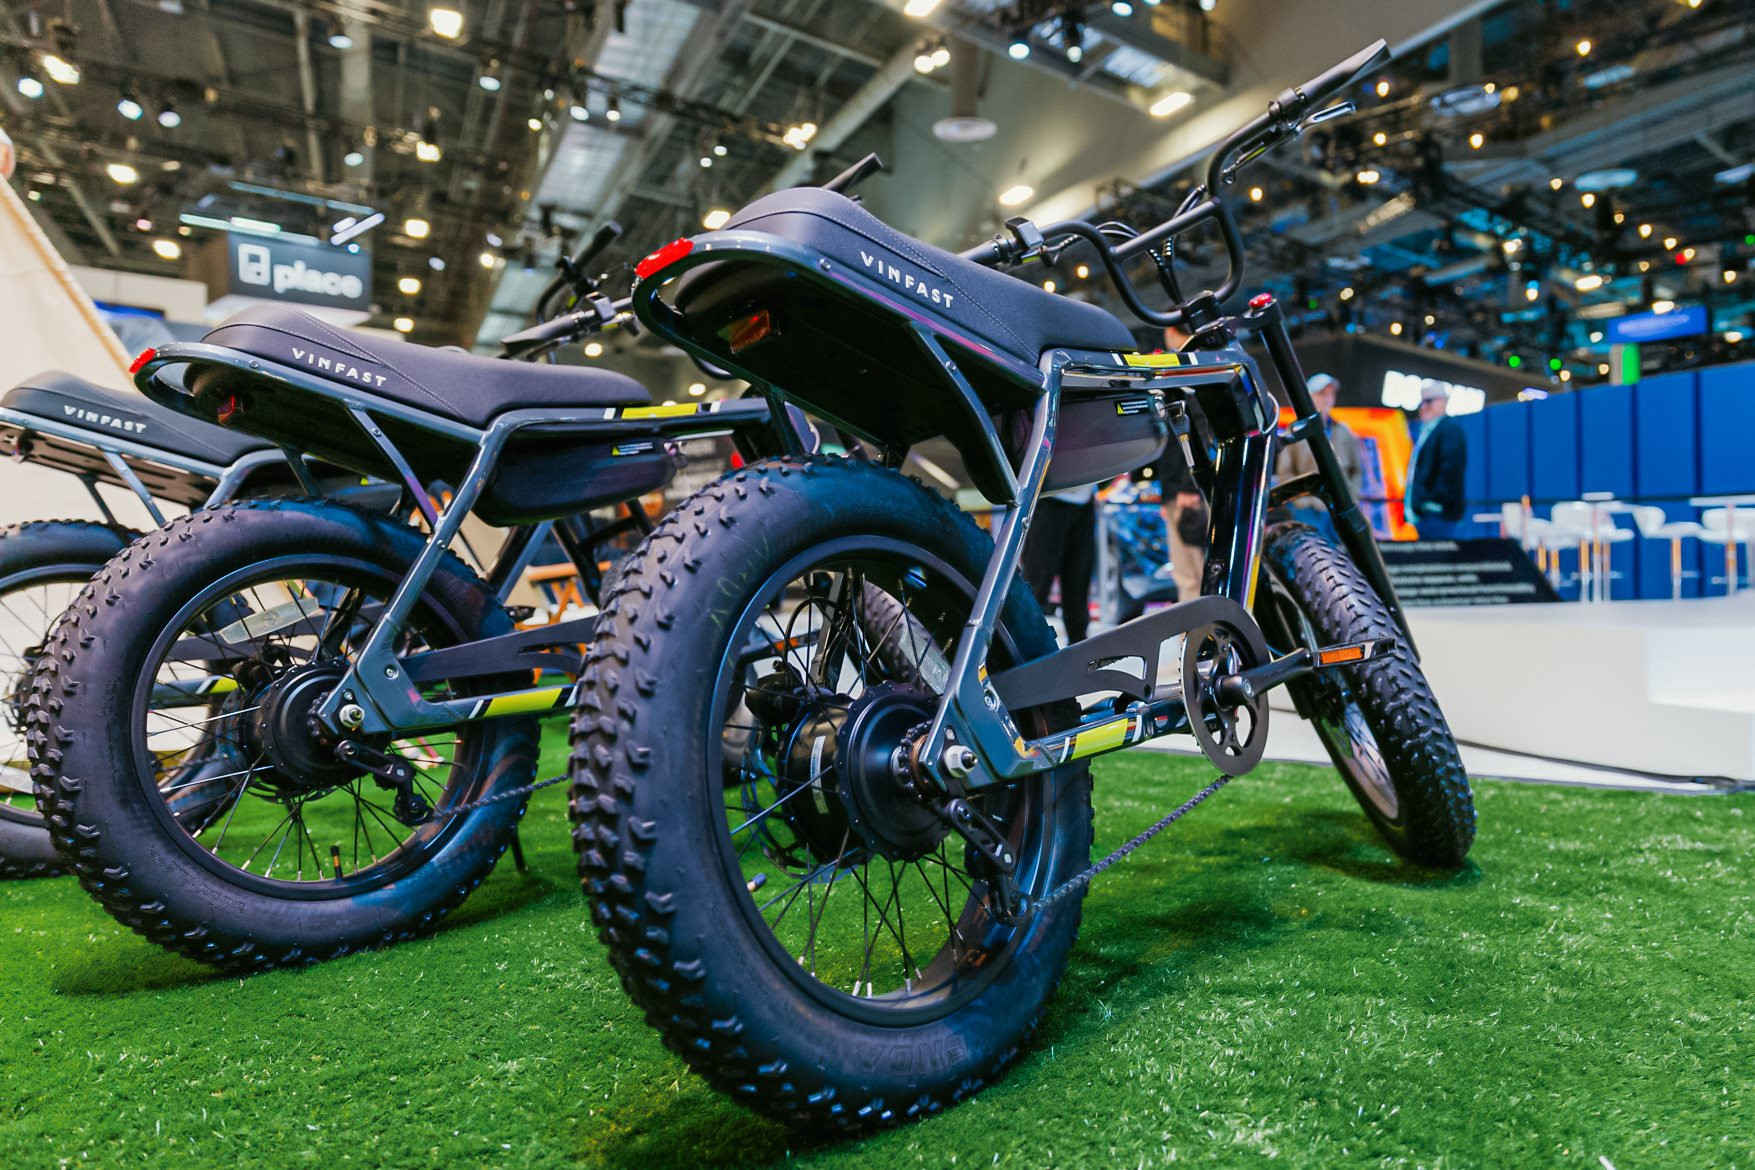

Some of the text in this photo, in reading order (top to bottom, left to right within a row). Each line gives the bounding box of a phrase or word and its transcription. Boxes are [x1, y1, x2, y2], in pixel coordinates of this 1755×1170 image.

[273, 260, 363, 299] place
[860, 250, 954, 309] VINFAST
[292, 347, 387, 387] VINFAST
[64, 405, 147, 434] VINFAST
